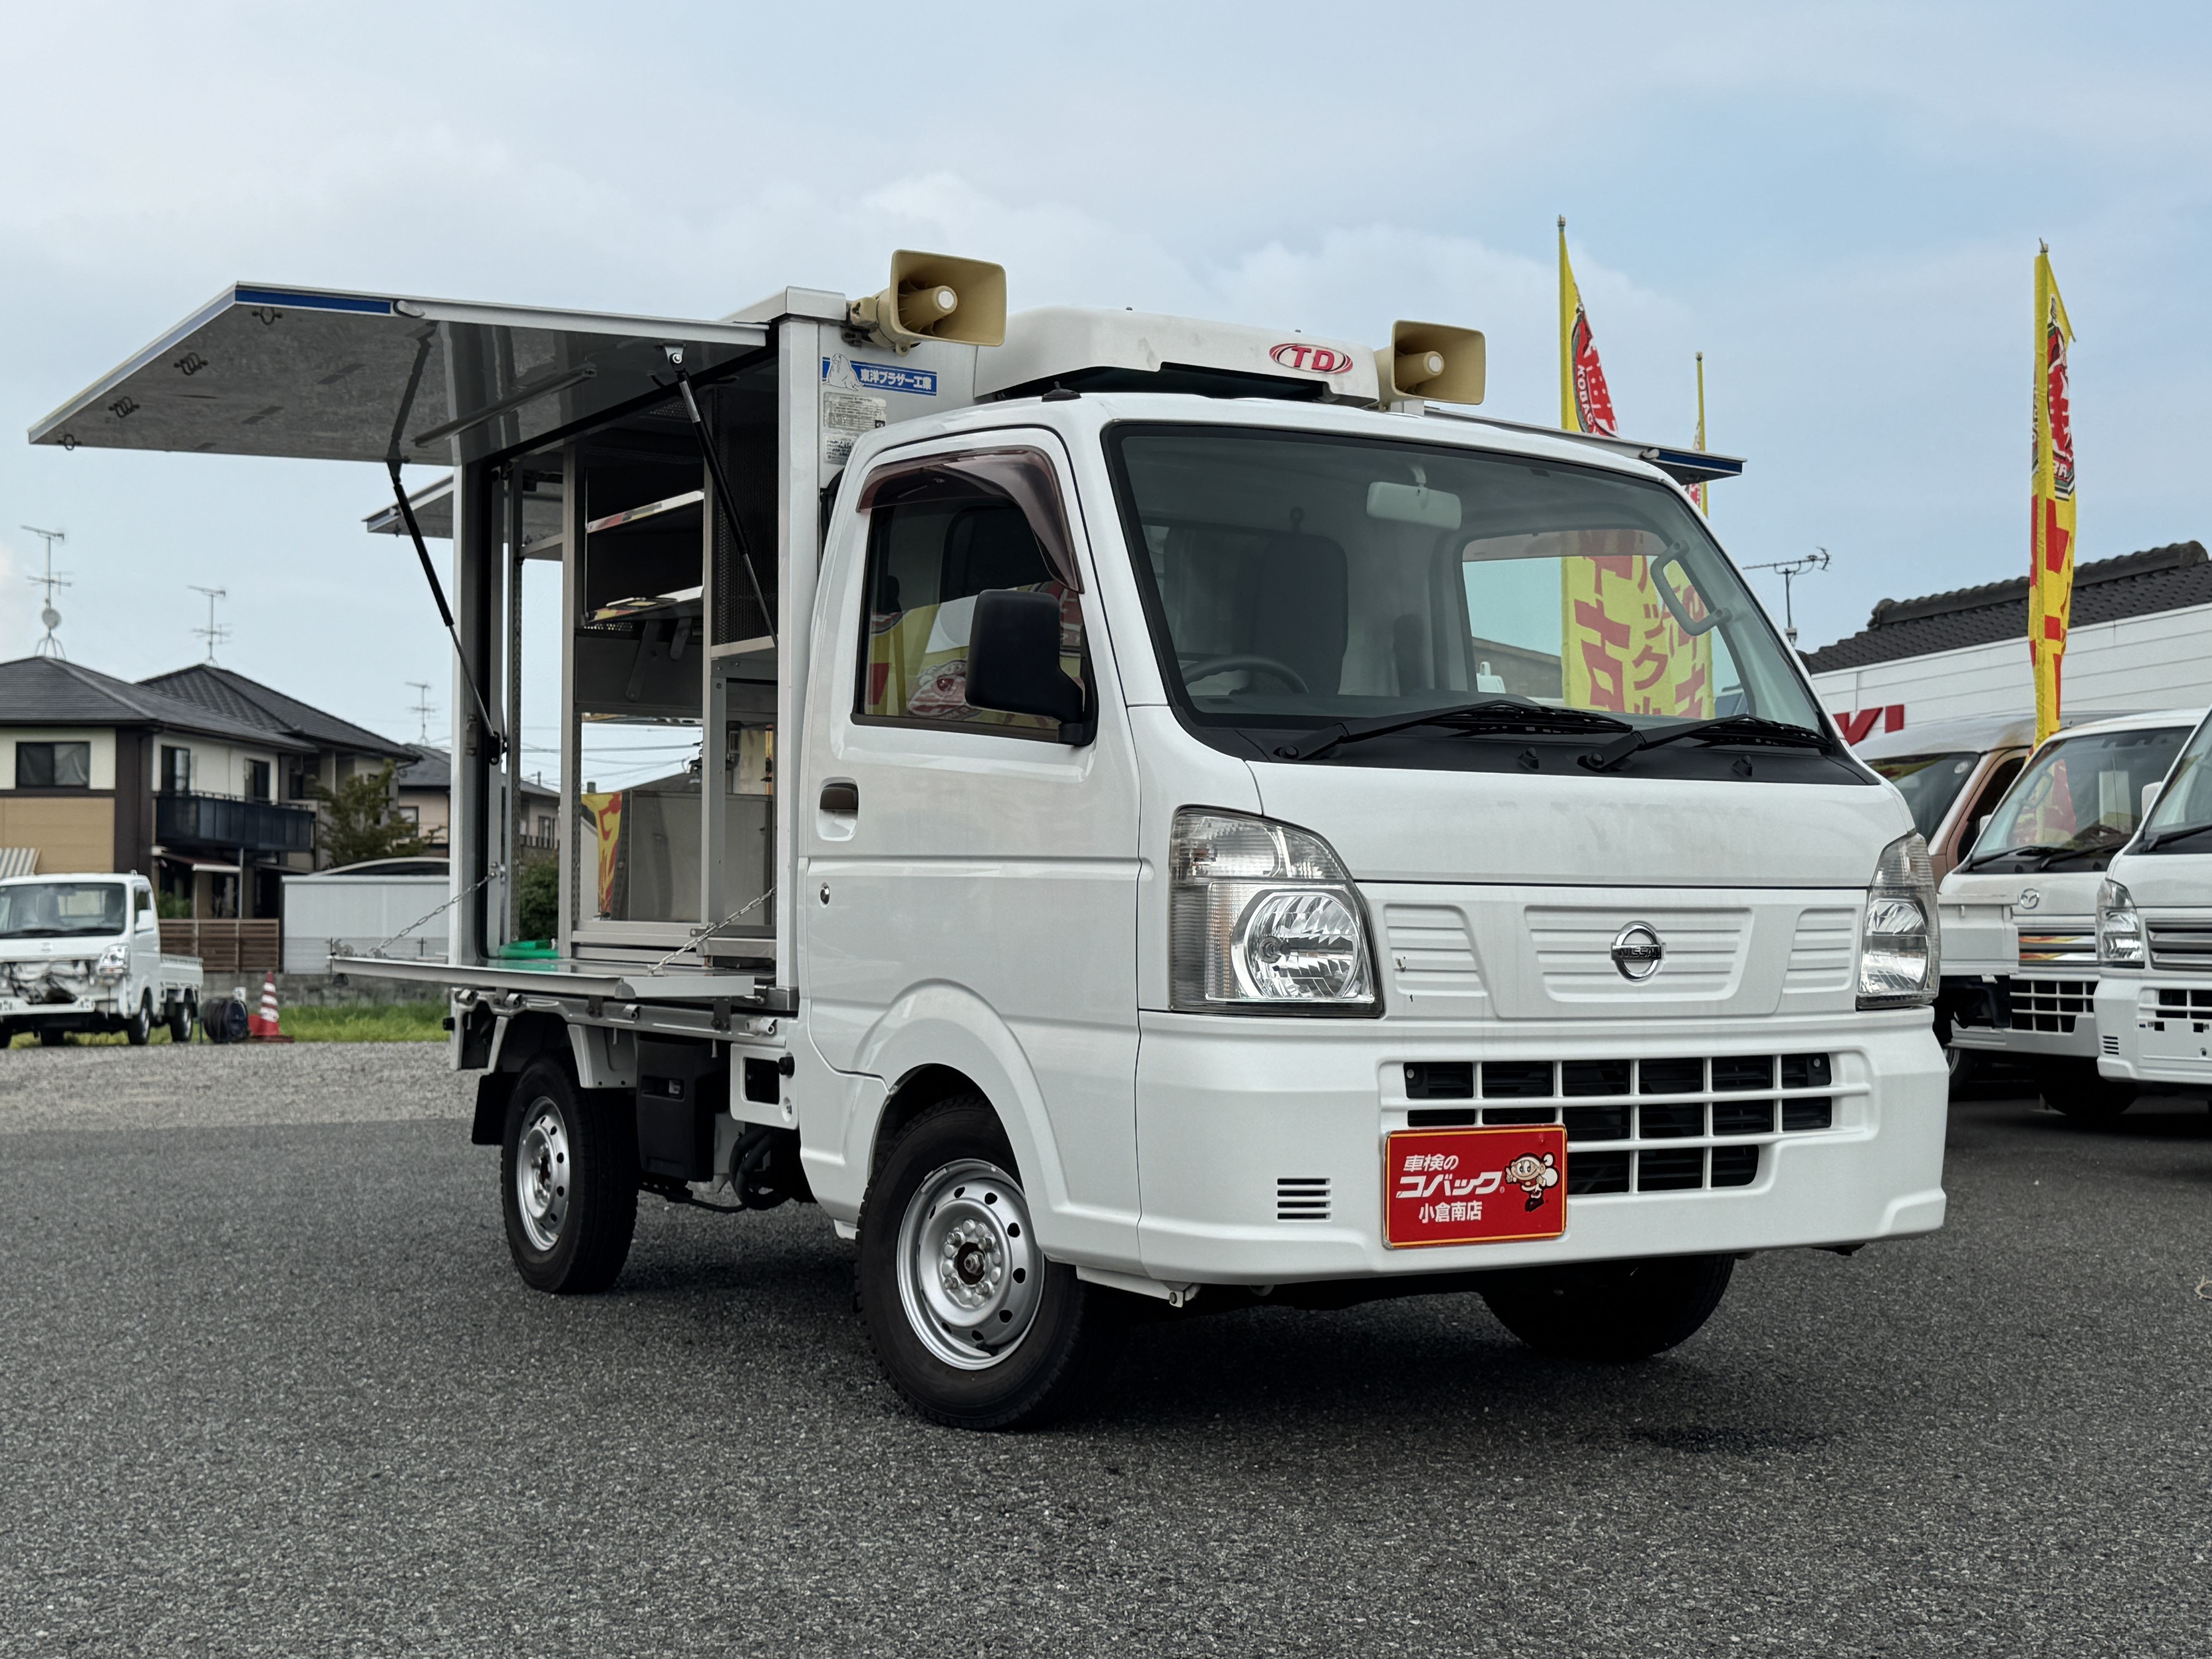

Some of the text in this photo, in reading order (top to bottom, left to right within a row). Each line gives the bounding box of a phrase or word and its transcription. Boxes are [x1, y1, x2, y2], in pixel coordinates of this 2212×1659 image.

[1291, 346, 1335, 371] TD
[1621, 947, 1661, 957] NISSAN
[1403, 1154, 1459, 1171] 車検の
[1396, 1171, 1503, 1198] コバック
[1419, 1200, 1482, 1223] 小倉南店
